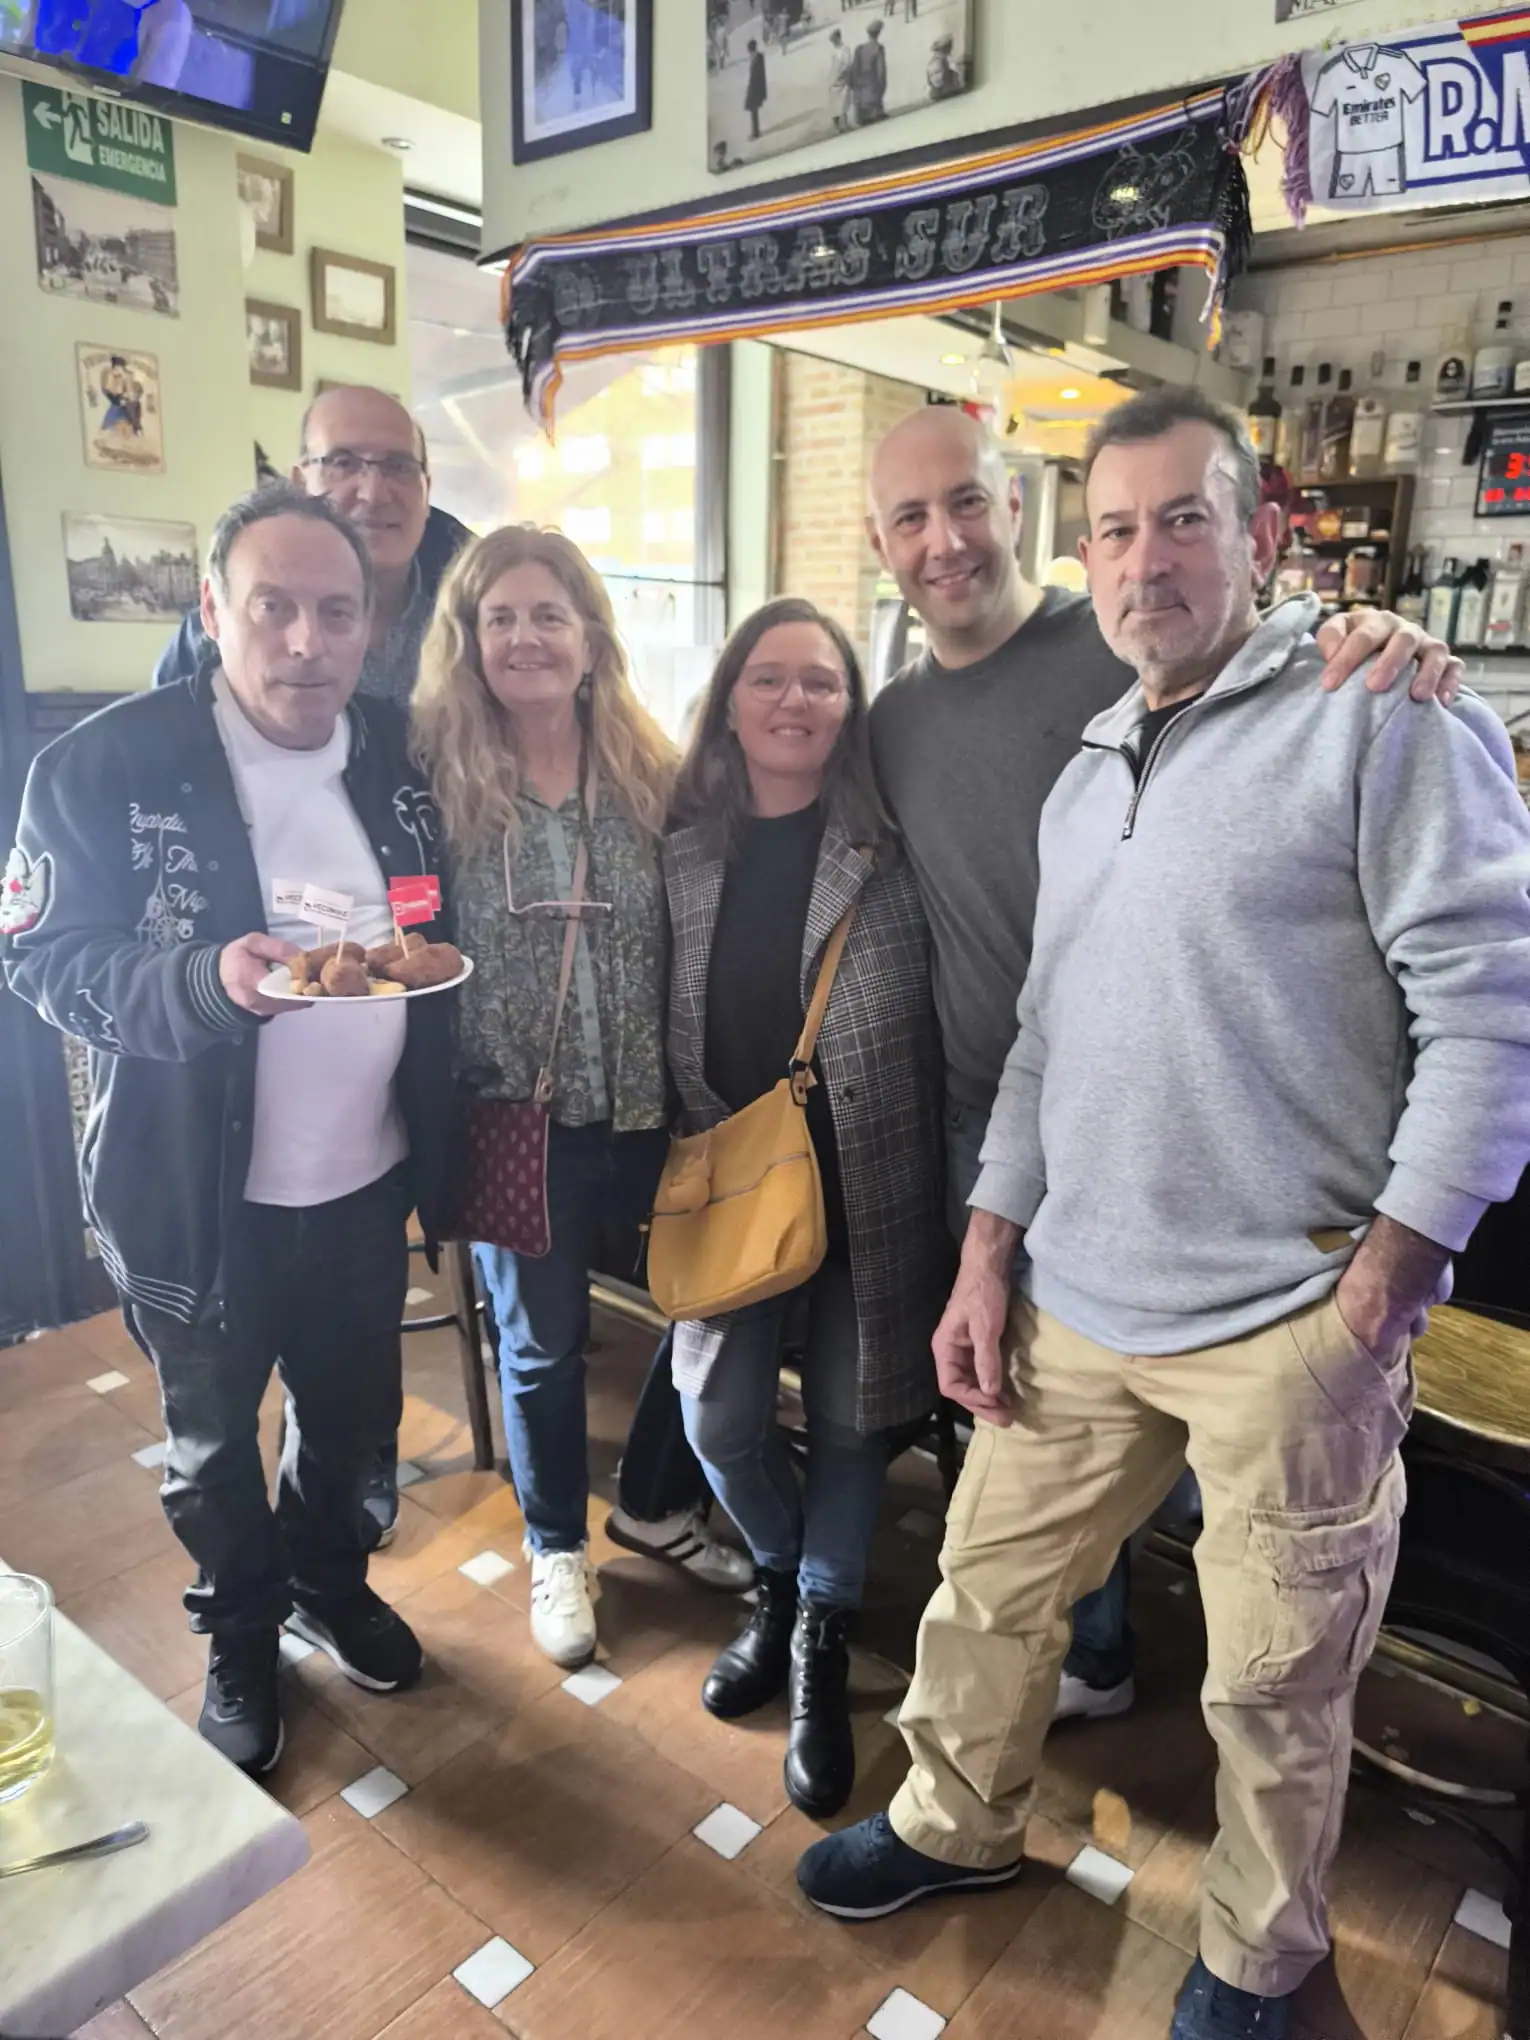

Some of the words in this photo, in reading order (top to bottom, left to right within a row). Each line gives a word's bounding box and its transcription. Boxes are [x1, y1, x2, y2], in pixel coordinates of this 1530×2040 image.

[96, 101, 165, 154] SALIDA
[1342, 97, 1396, 115] Emirates
[98, 145, 167, 183] EMERGENCIA
[622, 216, 873, 316] ULTRAS
[895, 185, 1050, 281] SUR
